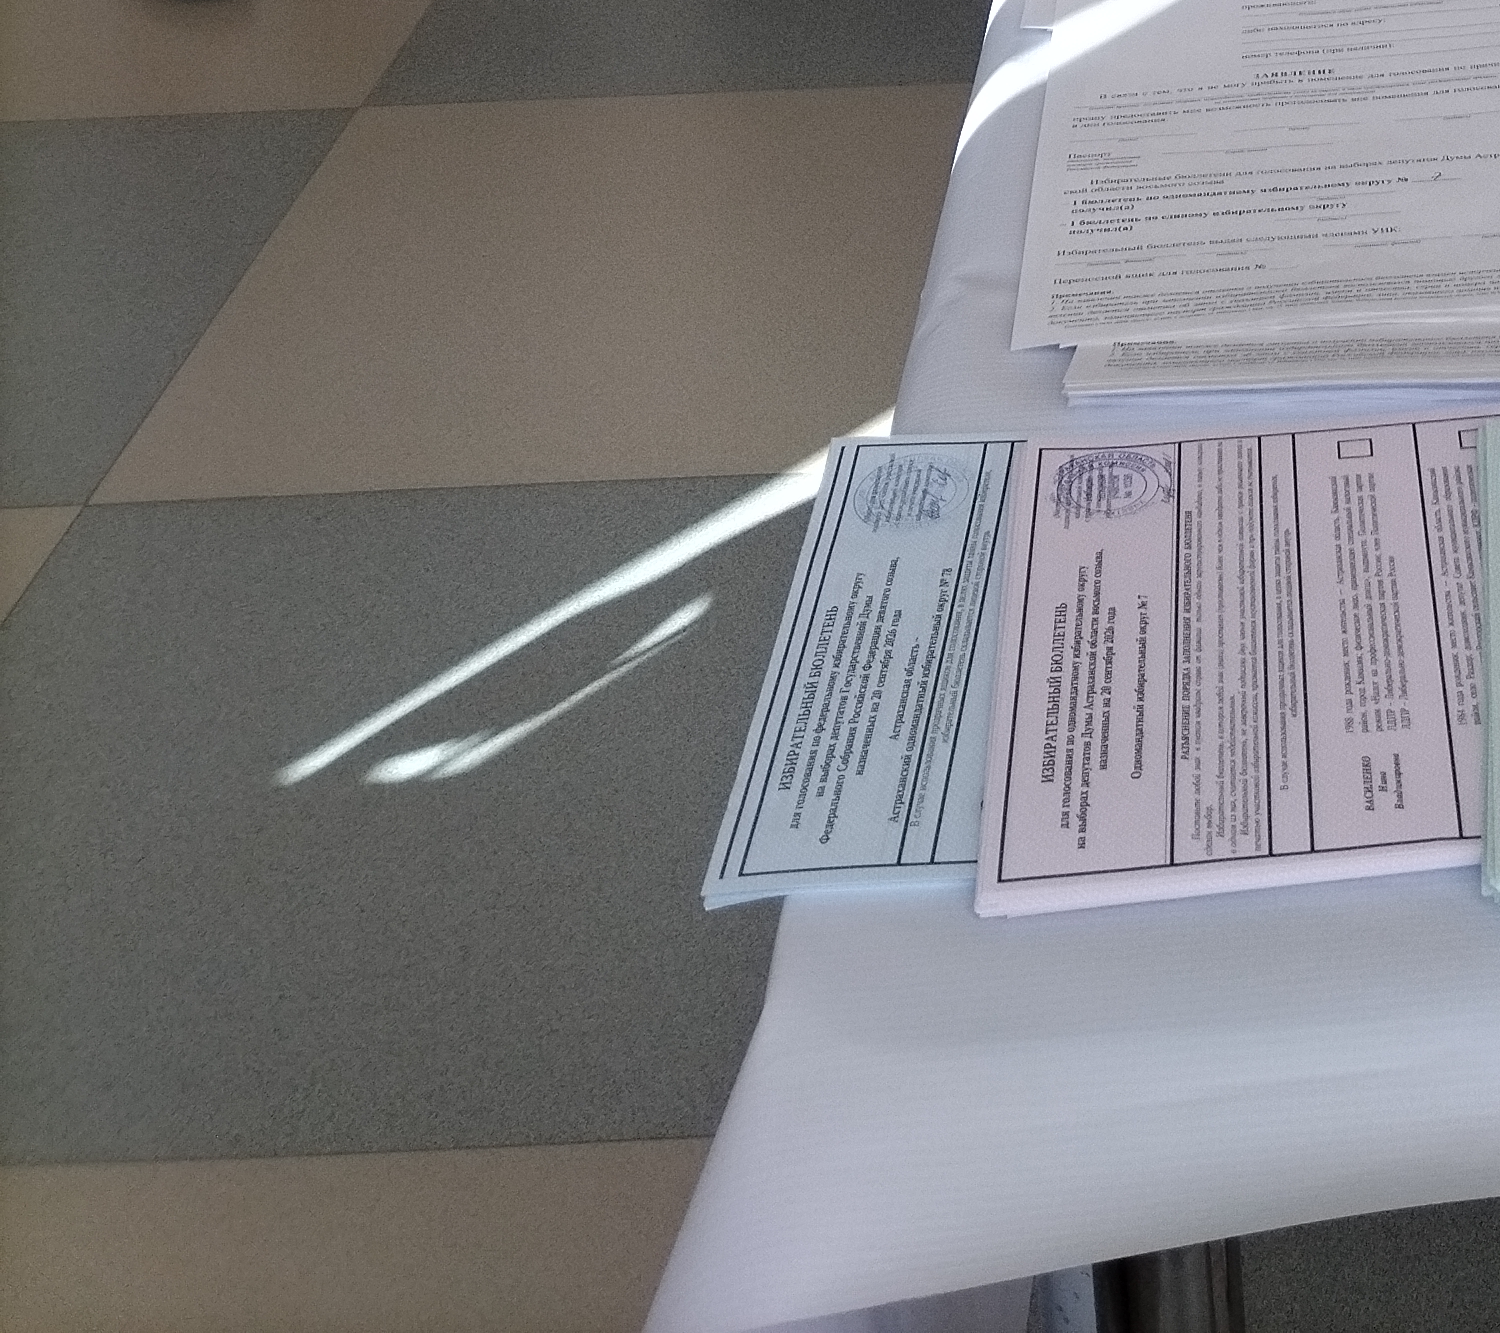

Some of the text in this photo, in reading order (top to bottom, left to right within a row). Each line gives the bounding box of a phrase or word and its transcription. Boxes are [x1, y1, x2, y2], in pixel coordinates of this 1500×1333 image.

[776, 605, 839, 790] ИЗБИРАТЕЛЬНЫЙ БЮЛЛЕТЕНЬ
[1038, 602, 1068, 783] ИЗБИРАТЕЛЬНЫЙ БЮЛЛЕТЕНЬ
[1360, 754, 1375, 811] ВАСИЛЕНКО
